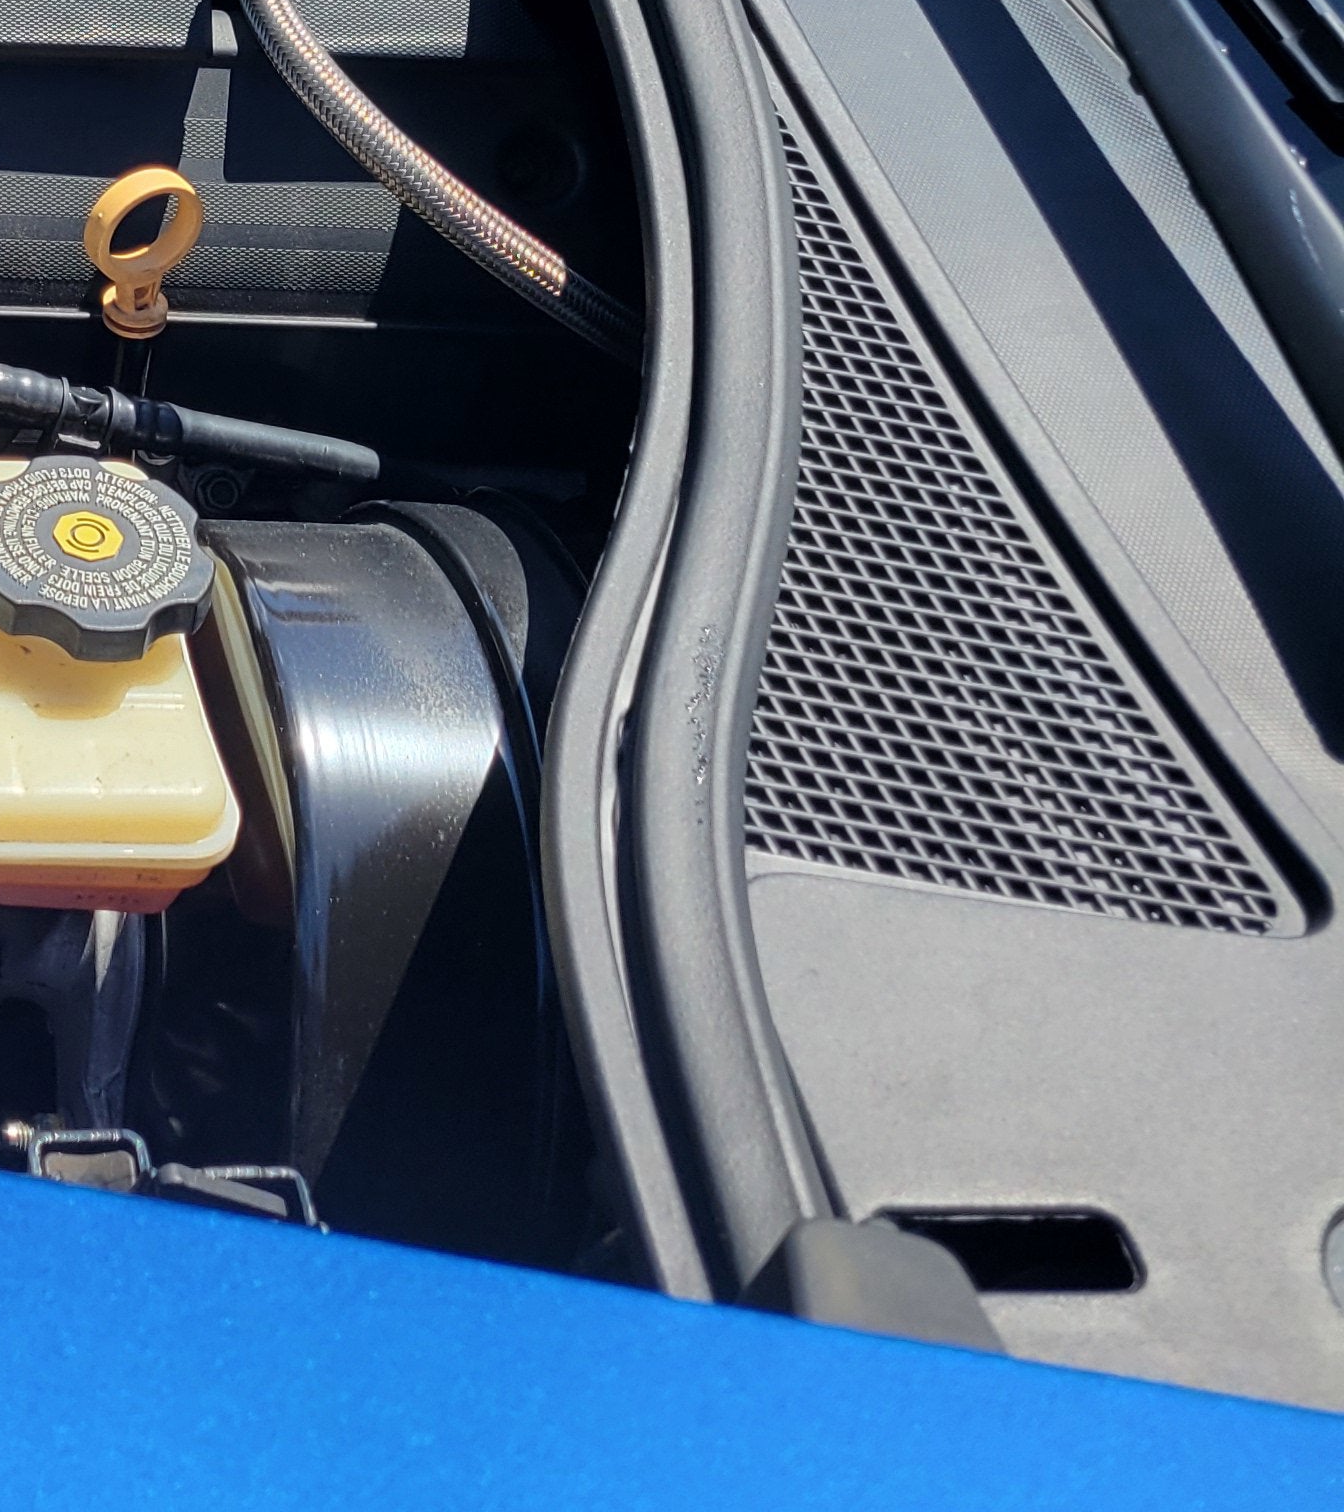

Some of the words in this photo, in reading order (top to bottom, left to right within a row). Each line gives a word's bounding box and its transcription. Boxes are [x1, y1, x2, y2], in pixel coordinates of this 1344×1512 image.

[24, 468, 58, 485] FLUID
[59, 468, 90, 479] DOT3
[24, 480, 68, 500] BEFORE
[70, 480, 92, 491] CAP
[95, 471, 159, 504] ATTENTION:
[97, 482, 162, 522] N'EMPLOYER
[21, 508, 40, 537] CLEAN
[96, 494, 153, 538] PROVENANT
[154, 523, 172, 543] QUE
[159, 505, 191, 548] NETTOYER
[6, 538, 26, 557] USE
[23, 538, 57, 569] FILLER
[159, 544, 173, 556] DU
[177, 550, 191, 563] LE
[18, 556, 47, 578] ONLY
[111, 560, 147, 582] BIDON
[137, 556, 171, 588] LIQUIDE
[48, 574, 80, 594] DOT3
[84, 584, 121, 597] FREIN
[122, 580, 141, 594] DE
[148, 562, 188, 599] BOUCHON
[91, 598, 110, 610] LA
[113, 592, 151, 610] AVANT
